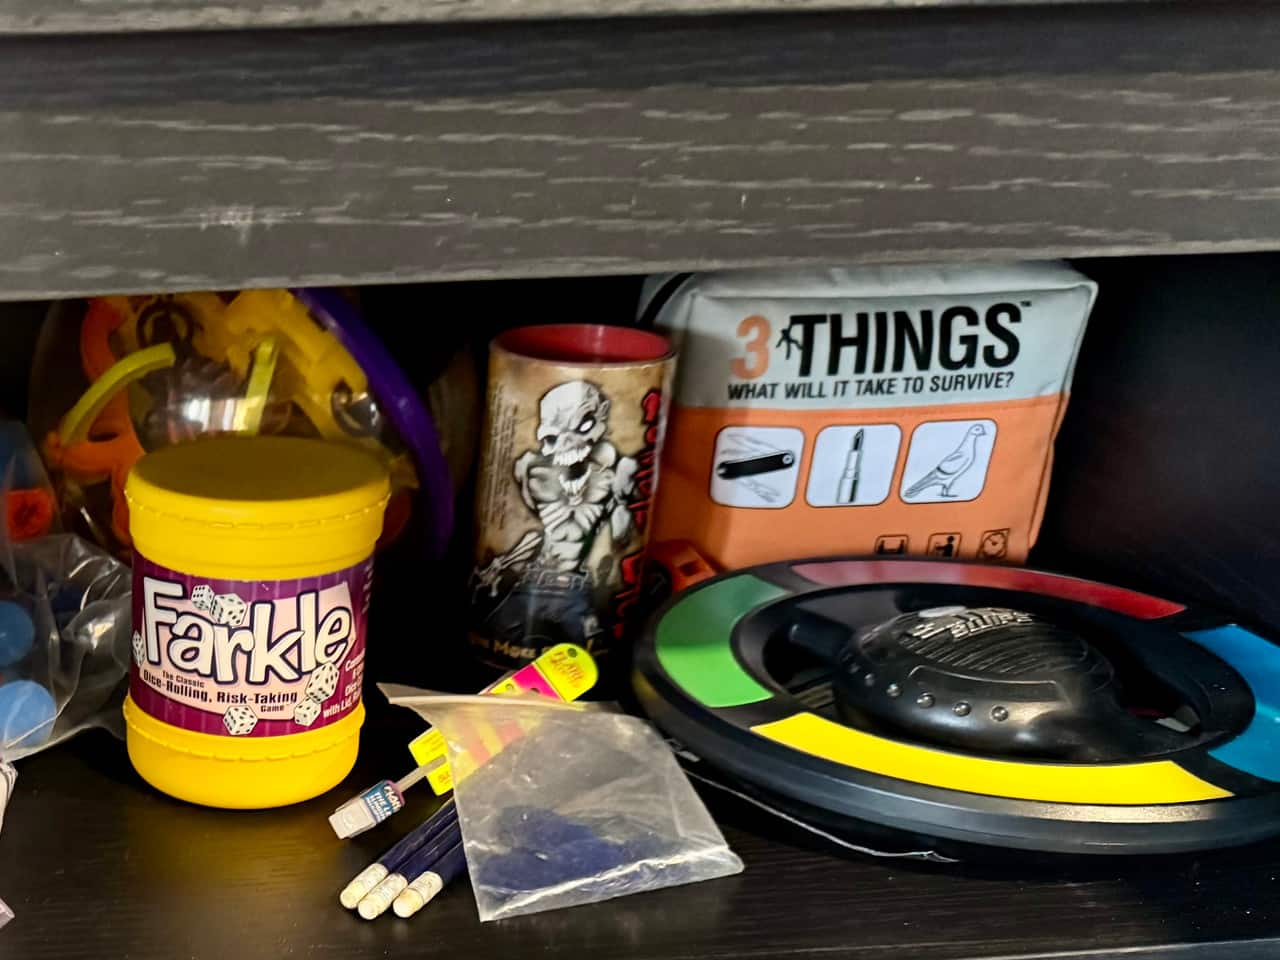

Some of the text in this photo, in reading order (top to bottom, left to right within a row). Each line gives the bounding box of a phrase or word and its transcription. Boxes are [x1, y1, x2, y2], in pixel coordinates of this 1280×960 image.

[731, 315, 772, 379] 3
[790, 302, 1023, 377] THINGS
[728, 371, 1014, 401] WHAT WILL IT TAKE TO SURVIVE?
[143, 576, 352, 686] Farkle
[143, 669, 298, 705] Dice-Rolling, Risk-Taking
[162, 671, 205, 688] The Classic
[260, 705, 284, 713] Game
